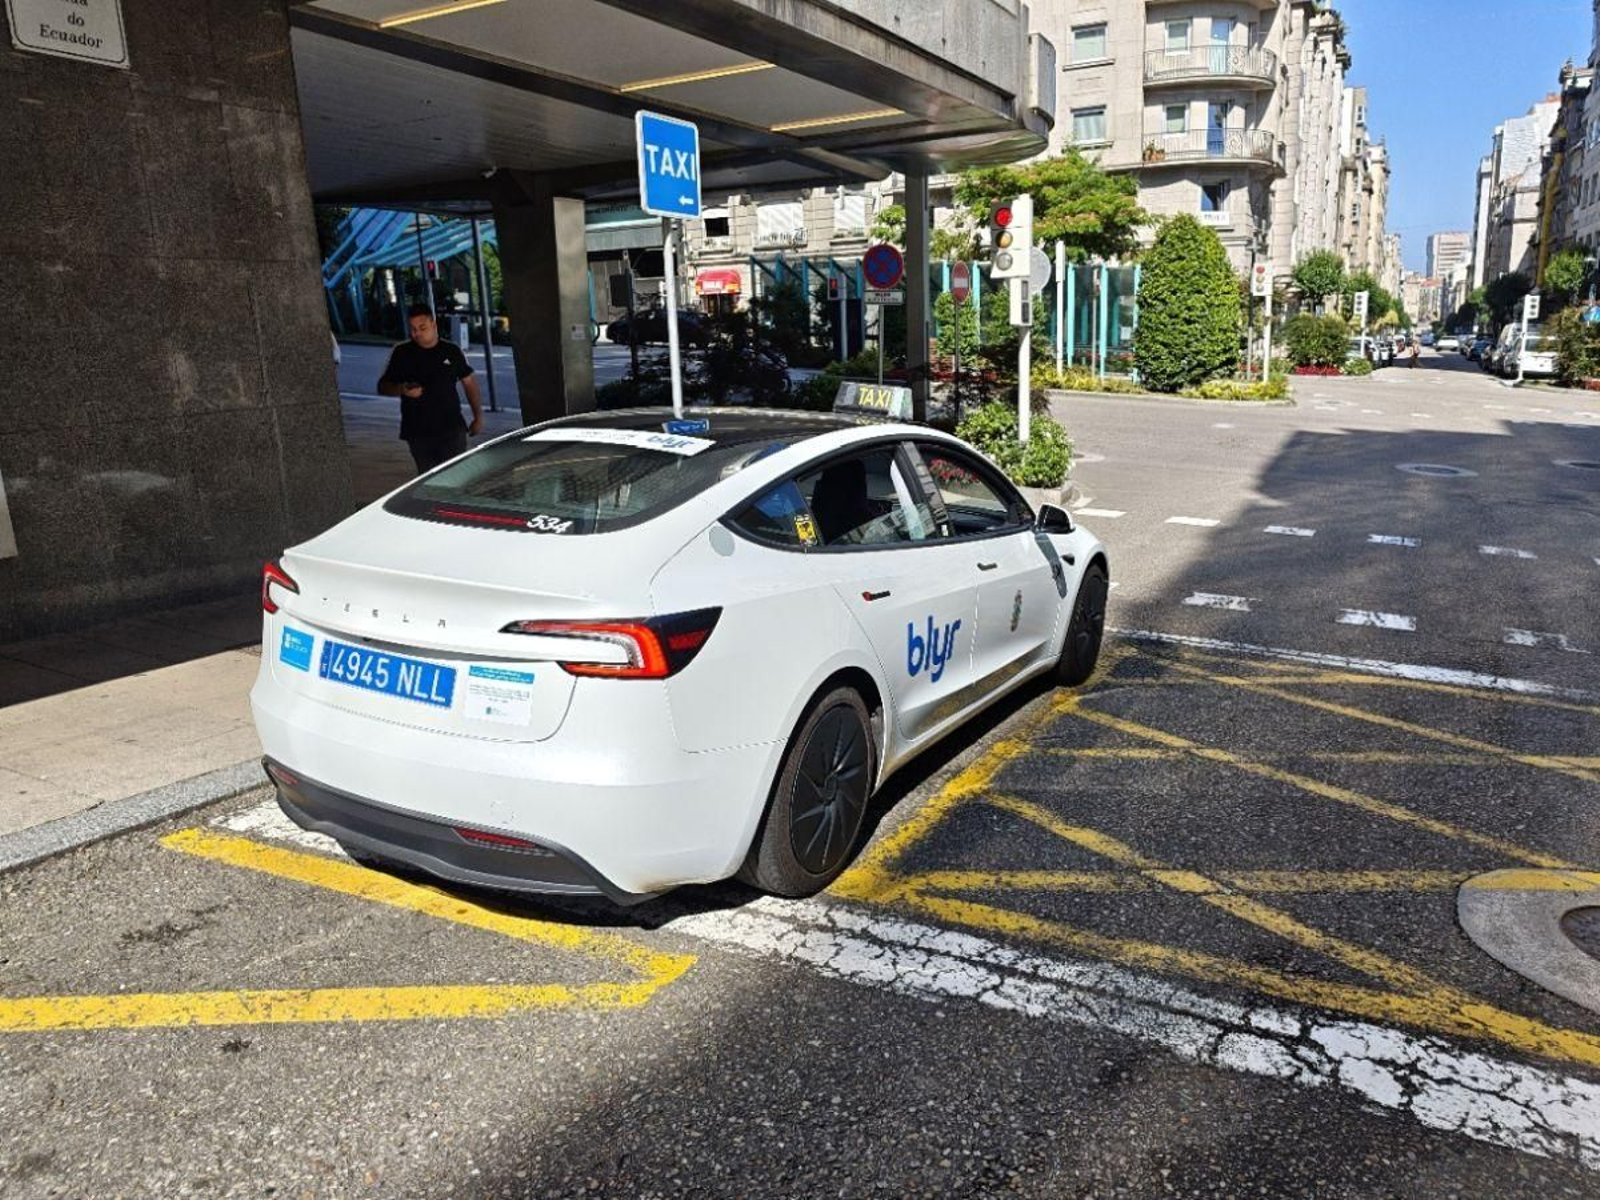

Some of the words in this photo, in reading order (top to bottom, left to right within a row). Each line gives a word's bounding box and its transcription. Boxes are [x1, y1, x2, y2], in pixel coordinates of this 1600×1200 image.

[67, 12, 85, 27] do
[40, 24, 103, 48] Ecuador
[645, 144, 696, 181] TAXI
[859, 387, 891, 408] TAXI
[526, 515, 573, 534] 534
[907, 615, 961, 683] blyr
[332, 648, 390, 689] 4945
[396, 662, 446, 702] NLL
